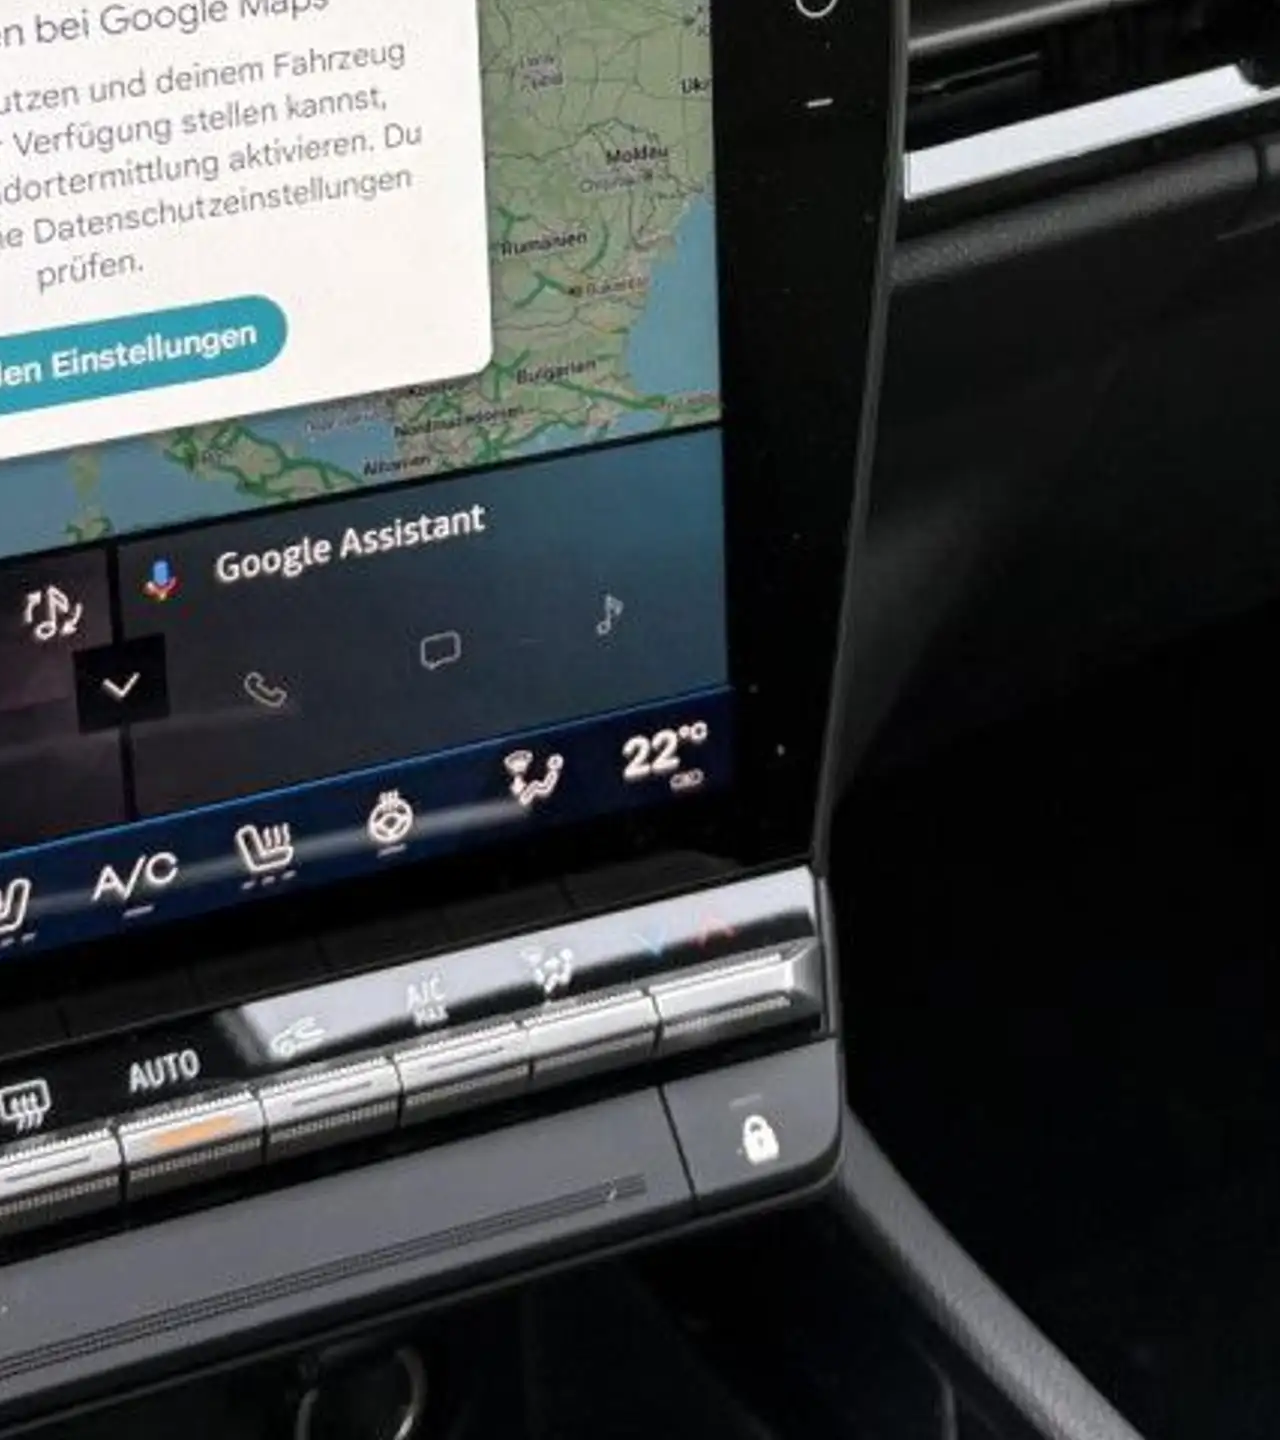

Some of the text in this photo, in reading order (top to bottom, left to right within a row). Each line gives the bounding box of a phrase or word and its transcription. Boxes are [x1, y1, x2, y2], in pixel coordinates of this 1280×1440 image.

[36, 8, 89, 44] bei
[89, 68, 146, 104] und
[156, 58, 265, 95] deinem
[273, 42, 406, 79] Fahrzeug
[13, 116, 171, 158] Verfügung
[181, 100, 277, 135] stellen
[286, 86, 387, 121] kannst,
[228, 133, 374, 173] aktivieren.
[383, 122, 423, 149] Du
[33, 168, 412, 246] Datenschutzeinstellungen
[36, 251, 144, 294] prüfen.
[52, 324, 258, 380] Einstellungen
[515, 359, 597, 385] Bulgarien
[216, 504, 486, 582] Google Assistant
[91, 852, 179, 903] A/C
[128, 1049, 200, 1094] AUTO
